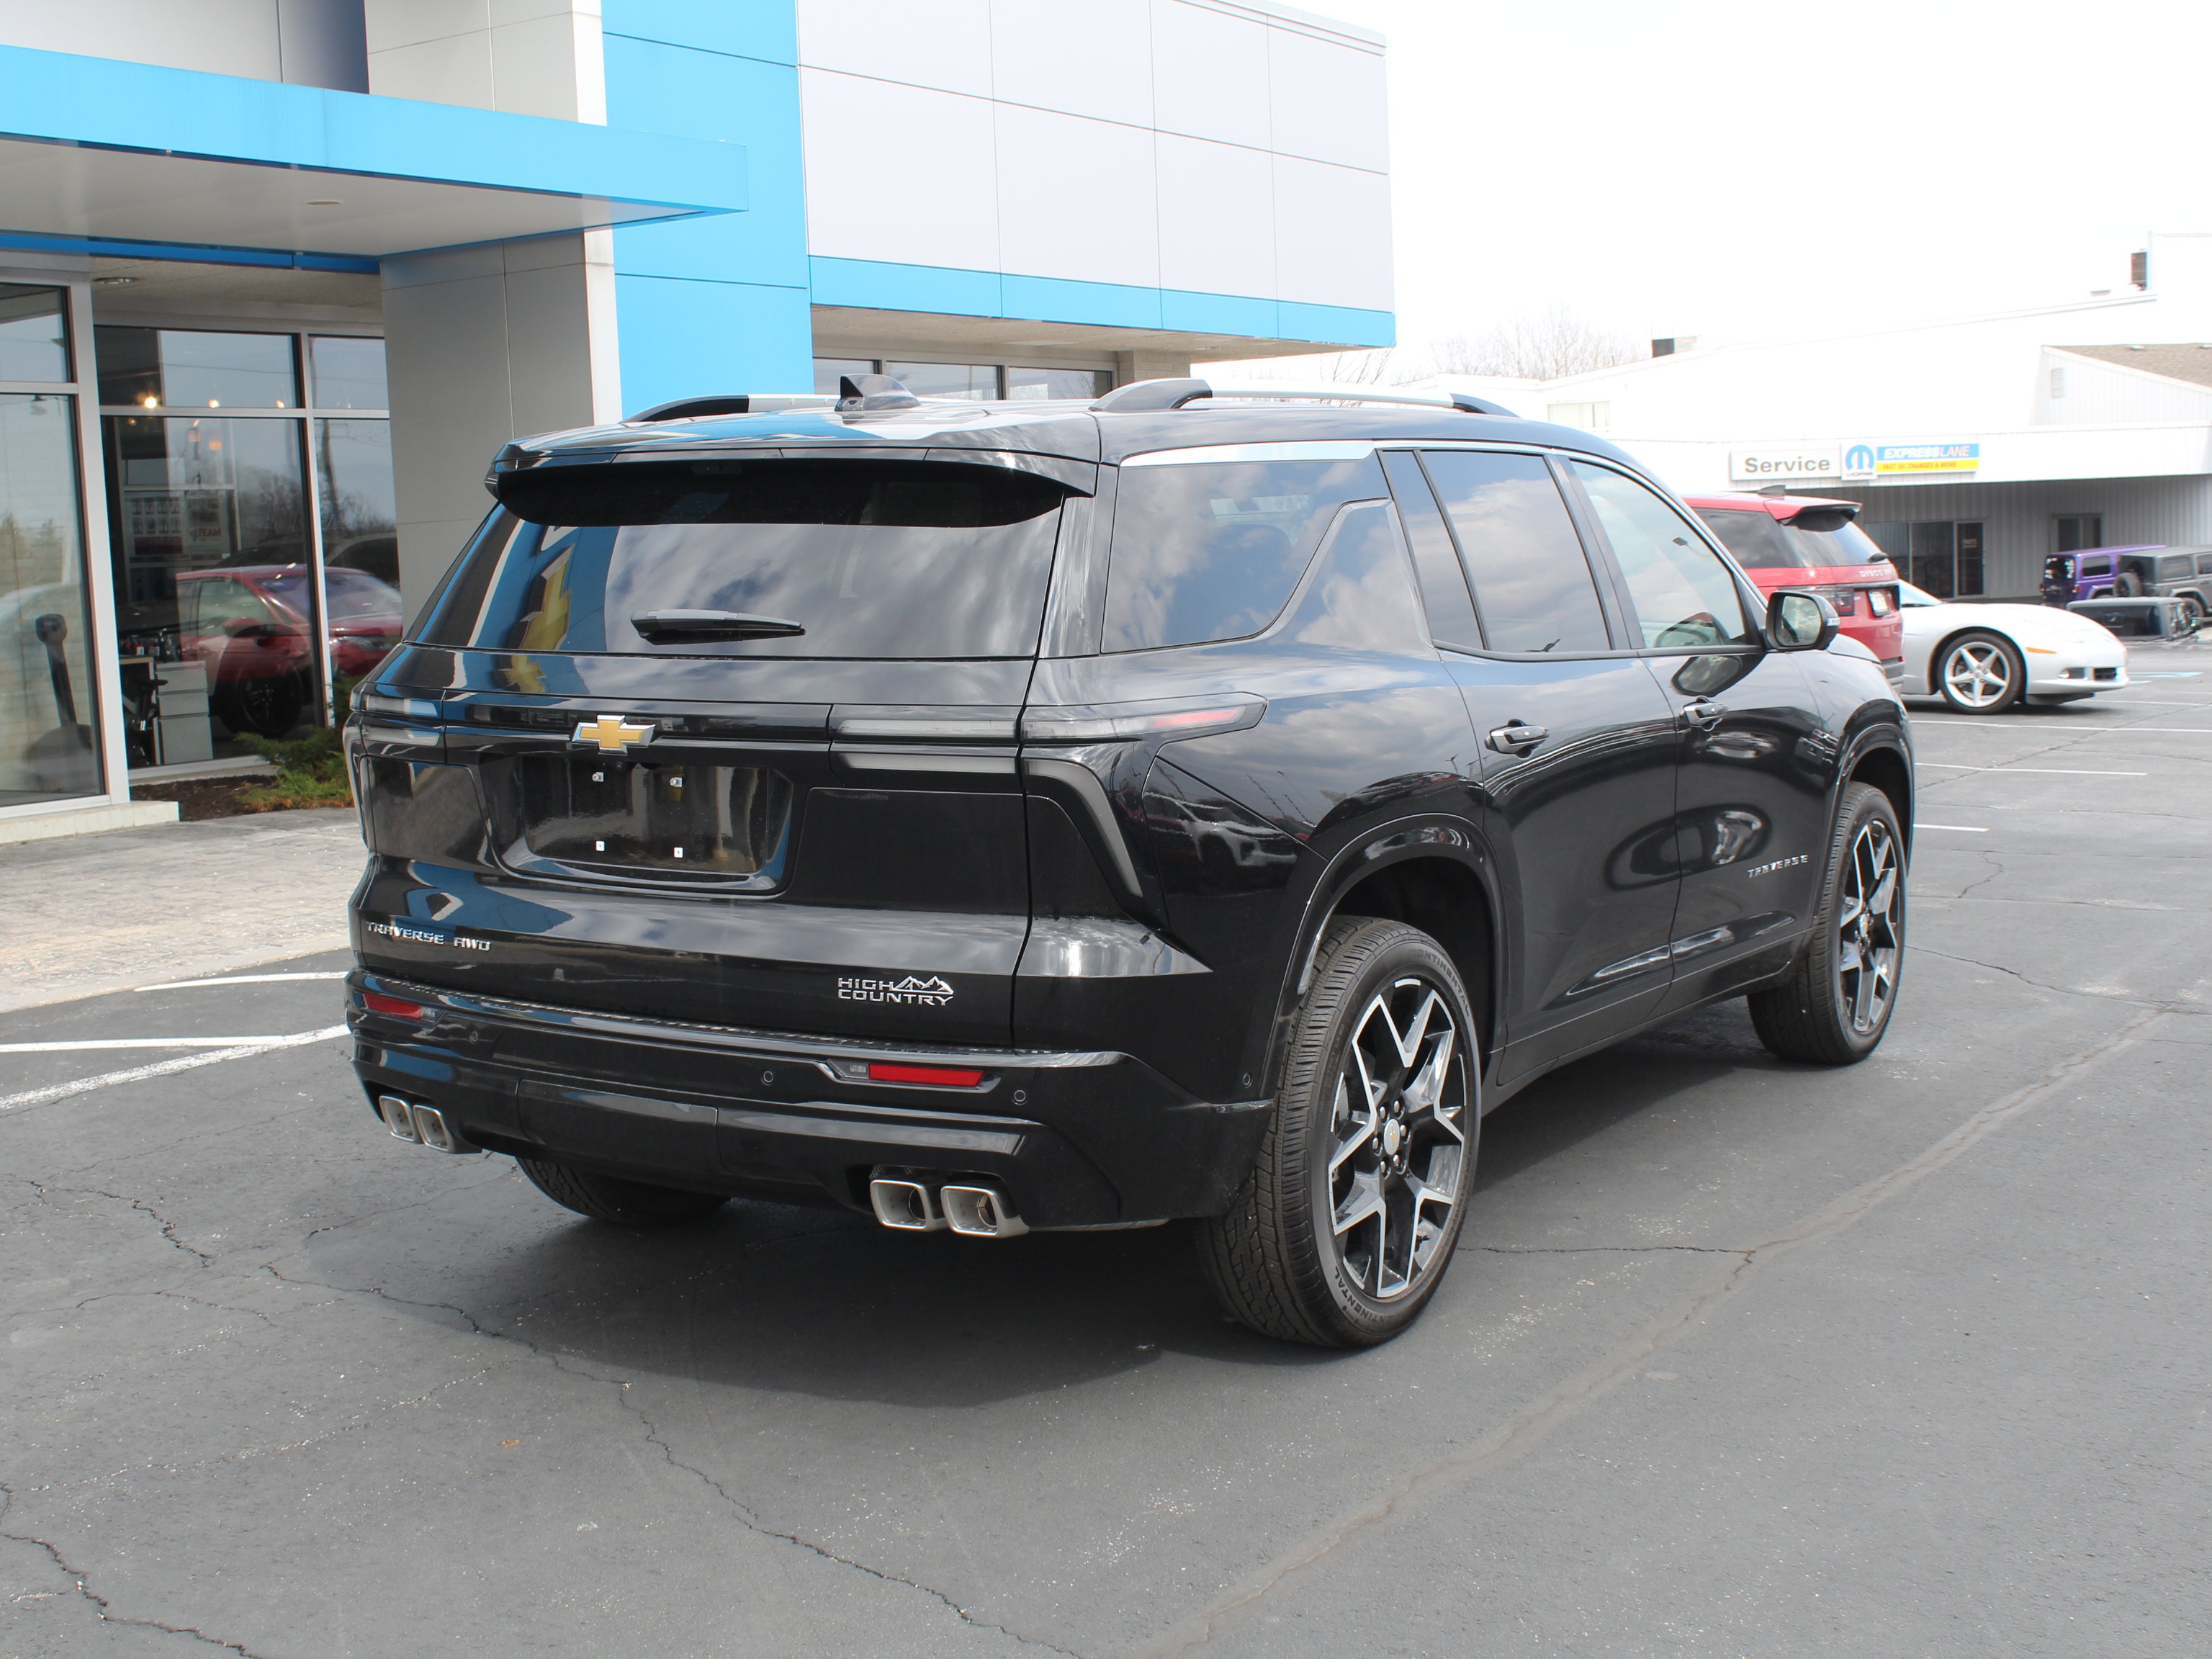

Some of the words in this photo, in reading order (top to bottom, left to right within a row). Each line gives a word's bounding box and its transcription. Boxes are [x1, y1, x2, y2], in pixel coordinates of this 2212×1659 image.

[1744, 456, 1830, 473] Service
[1747, 855, 1809, 878] TRAVERSE
[366, 921, 444, 945] TRAVERSE
[454, 937, 492, 951] AWD
[837, 977, 894, 991] HIGH
[1408, 948, 1470, 1017] CONTINENTAL
[837, 989, 954, 1006] COUNTRY
[1335, 1265, 1393, 1323] NTINENTAL
